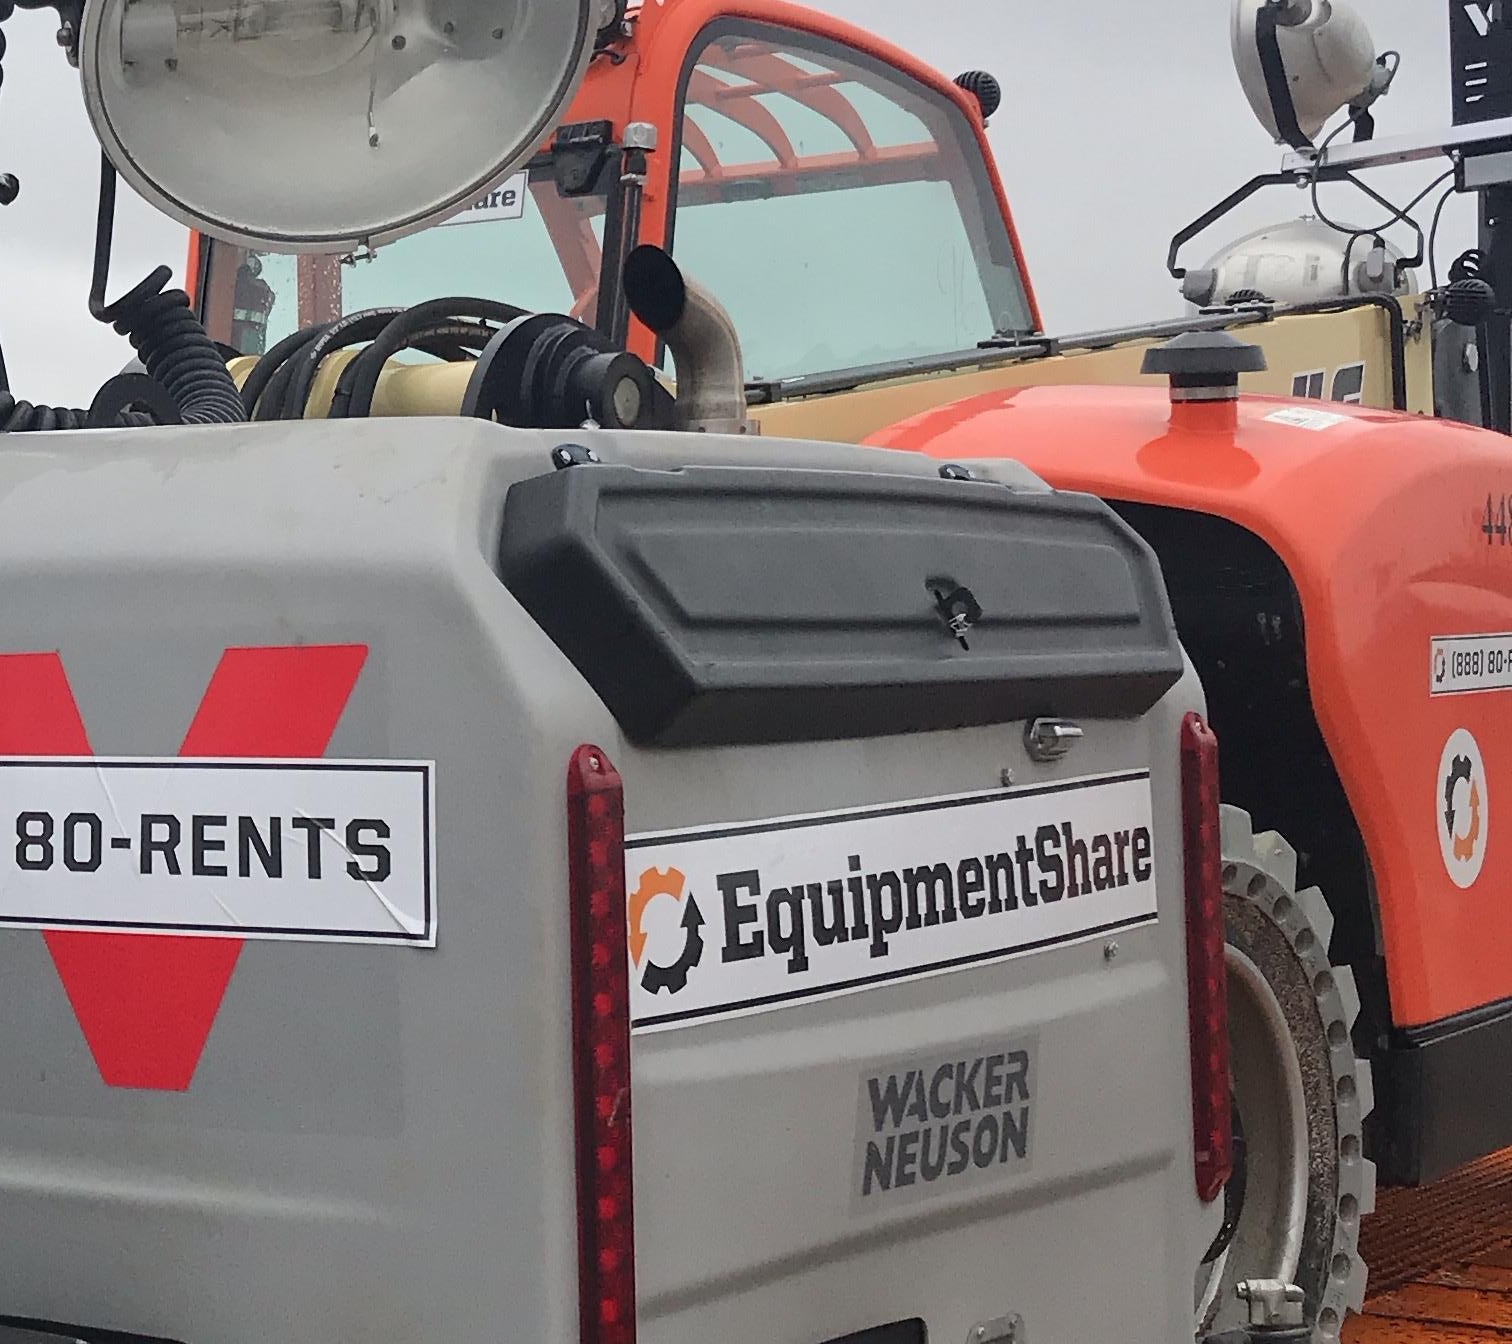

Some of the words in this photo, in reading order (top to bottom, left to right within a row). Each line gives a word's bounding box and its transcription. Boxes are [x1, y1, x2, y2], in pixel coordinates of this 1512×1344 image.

[1451, 648, 1485, 678] (888)
[16, 811, 391, 883] 80-RENTS
[717, 821, 1152, 974] EquipmentShare
[867, 1049, 1030, 1132] WACKER
[862, 1106, 1029, 1196] NEUSON
